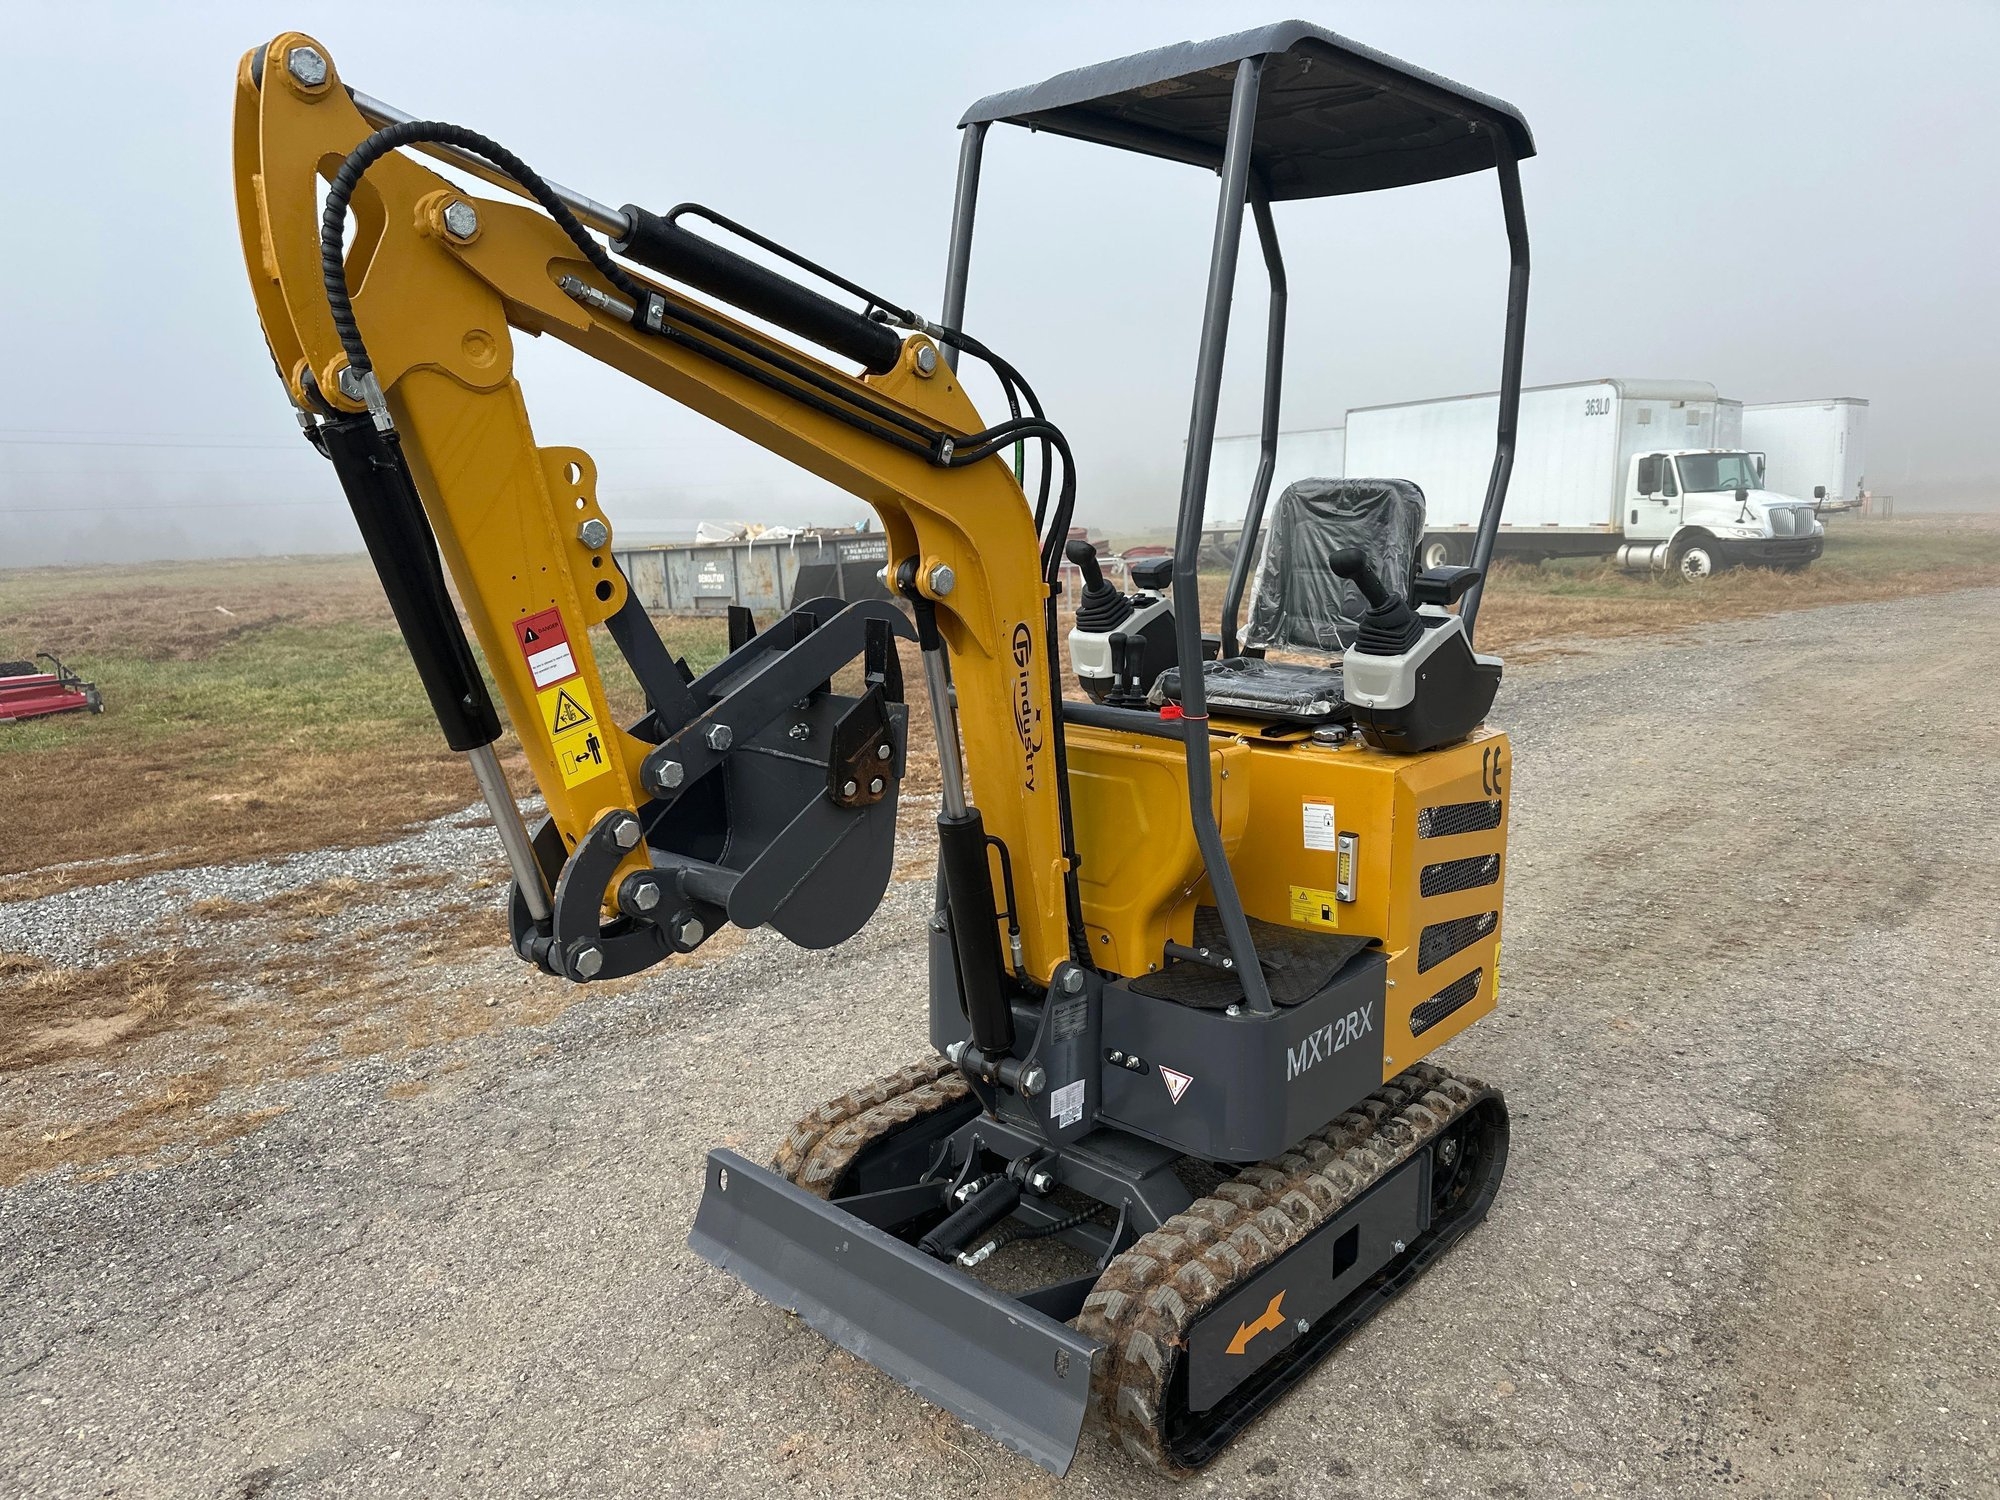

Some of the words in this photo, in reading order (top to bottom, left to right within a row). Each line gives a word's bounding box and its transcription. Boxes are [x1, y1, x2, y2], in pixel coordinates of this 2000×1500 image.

[538, 622, 559, 633] DANGER
[1483, 746, 1502, 796] CE
[1287, 1000, 1373, 1082] MX12RX
